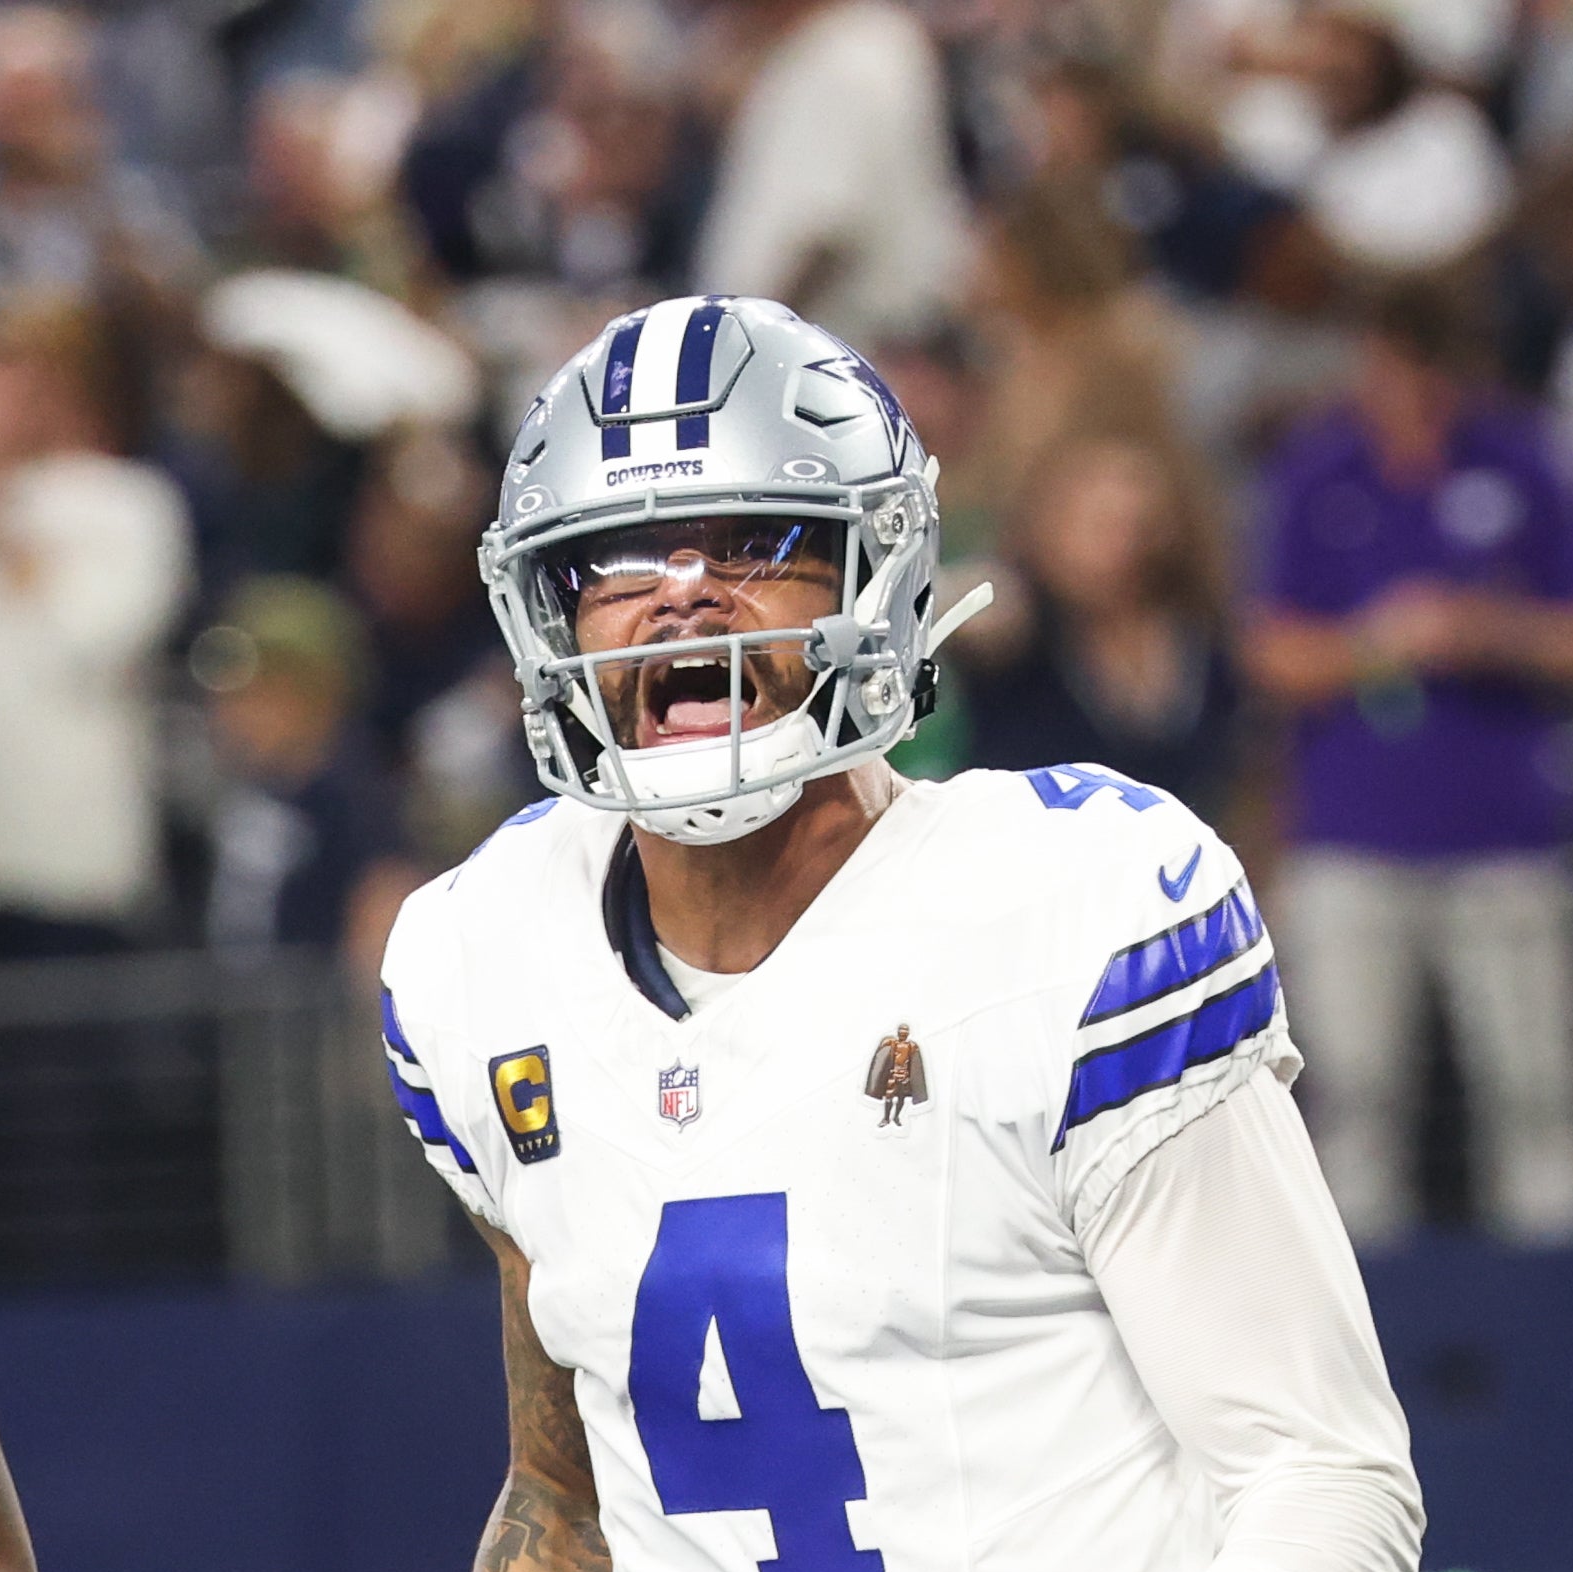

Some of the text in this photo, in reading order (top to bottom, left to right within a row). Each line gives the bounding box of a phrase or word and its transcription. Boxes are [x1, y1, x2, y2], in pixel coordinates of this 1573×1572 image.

[605, 459, 704, 488] COWBOYS
[1023, 763, 1166, 812] 4
[495, 1054, 550, 1134] C
[662, 1090, 696, 1118] NFL
